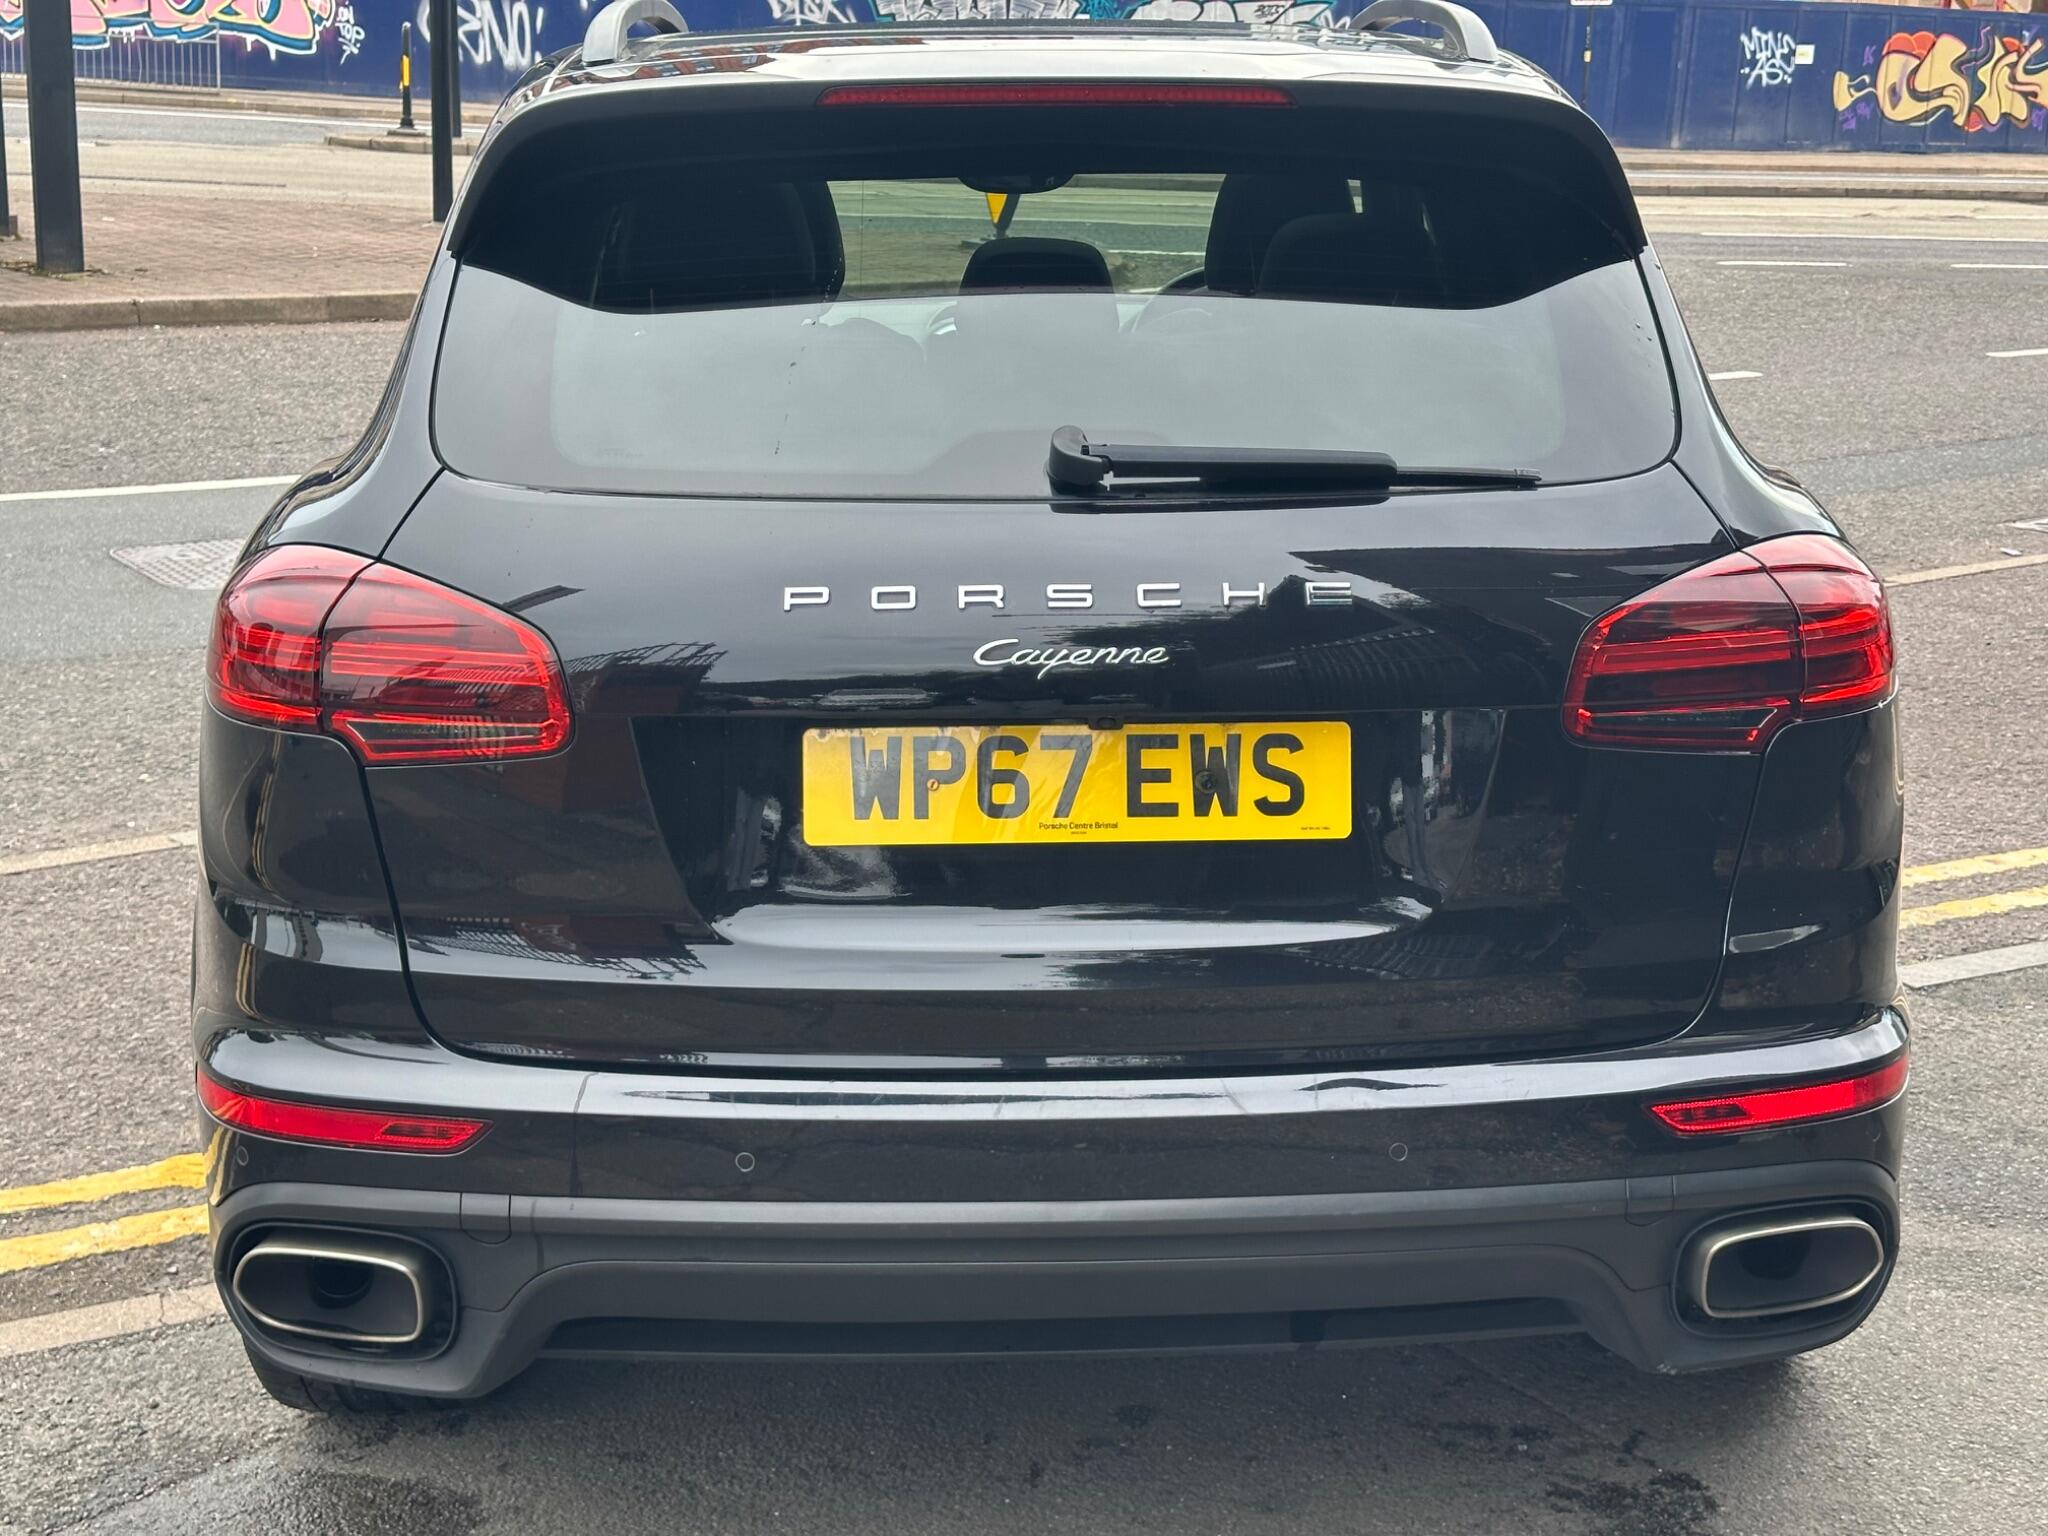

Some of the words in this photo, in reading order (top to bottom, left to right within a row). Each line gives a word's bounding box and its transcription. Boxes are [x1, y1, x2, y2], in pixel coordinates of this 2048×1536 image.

[783, 582, 1353, 611] PORSCHE
[973, 638, 1169, 680] Cayenne
[851, 734, 1093, 820] WP67
[1126, 733, 1305, 817] EWS
[1038, 822, 1068, 830] Porsche
[1069, 821, 1094, 829] Centre
[1094, 821, 1118, 829] Bristol
